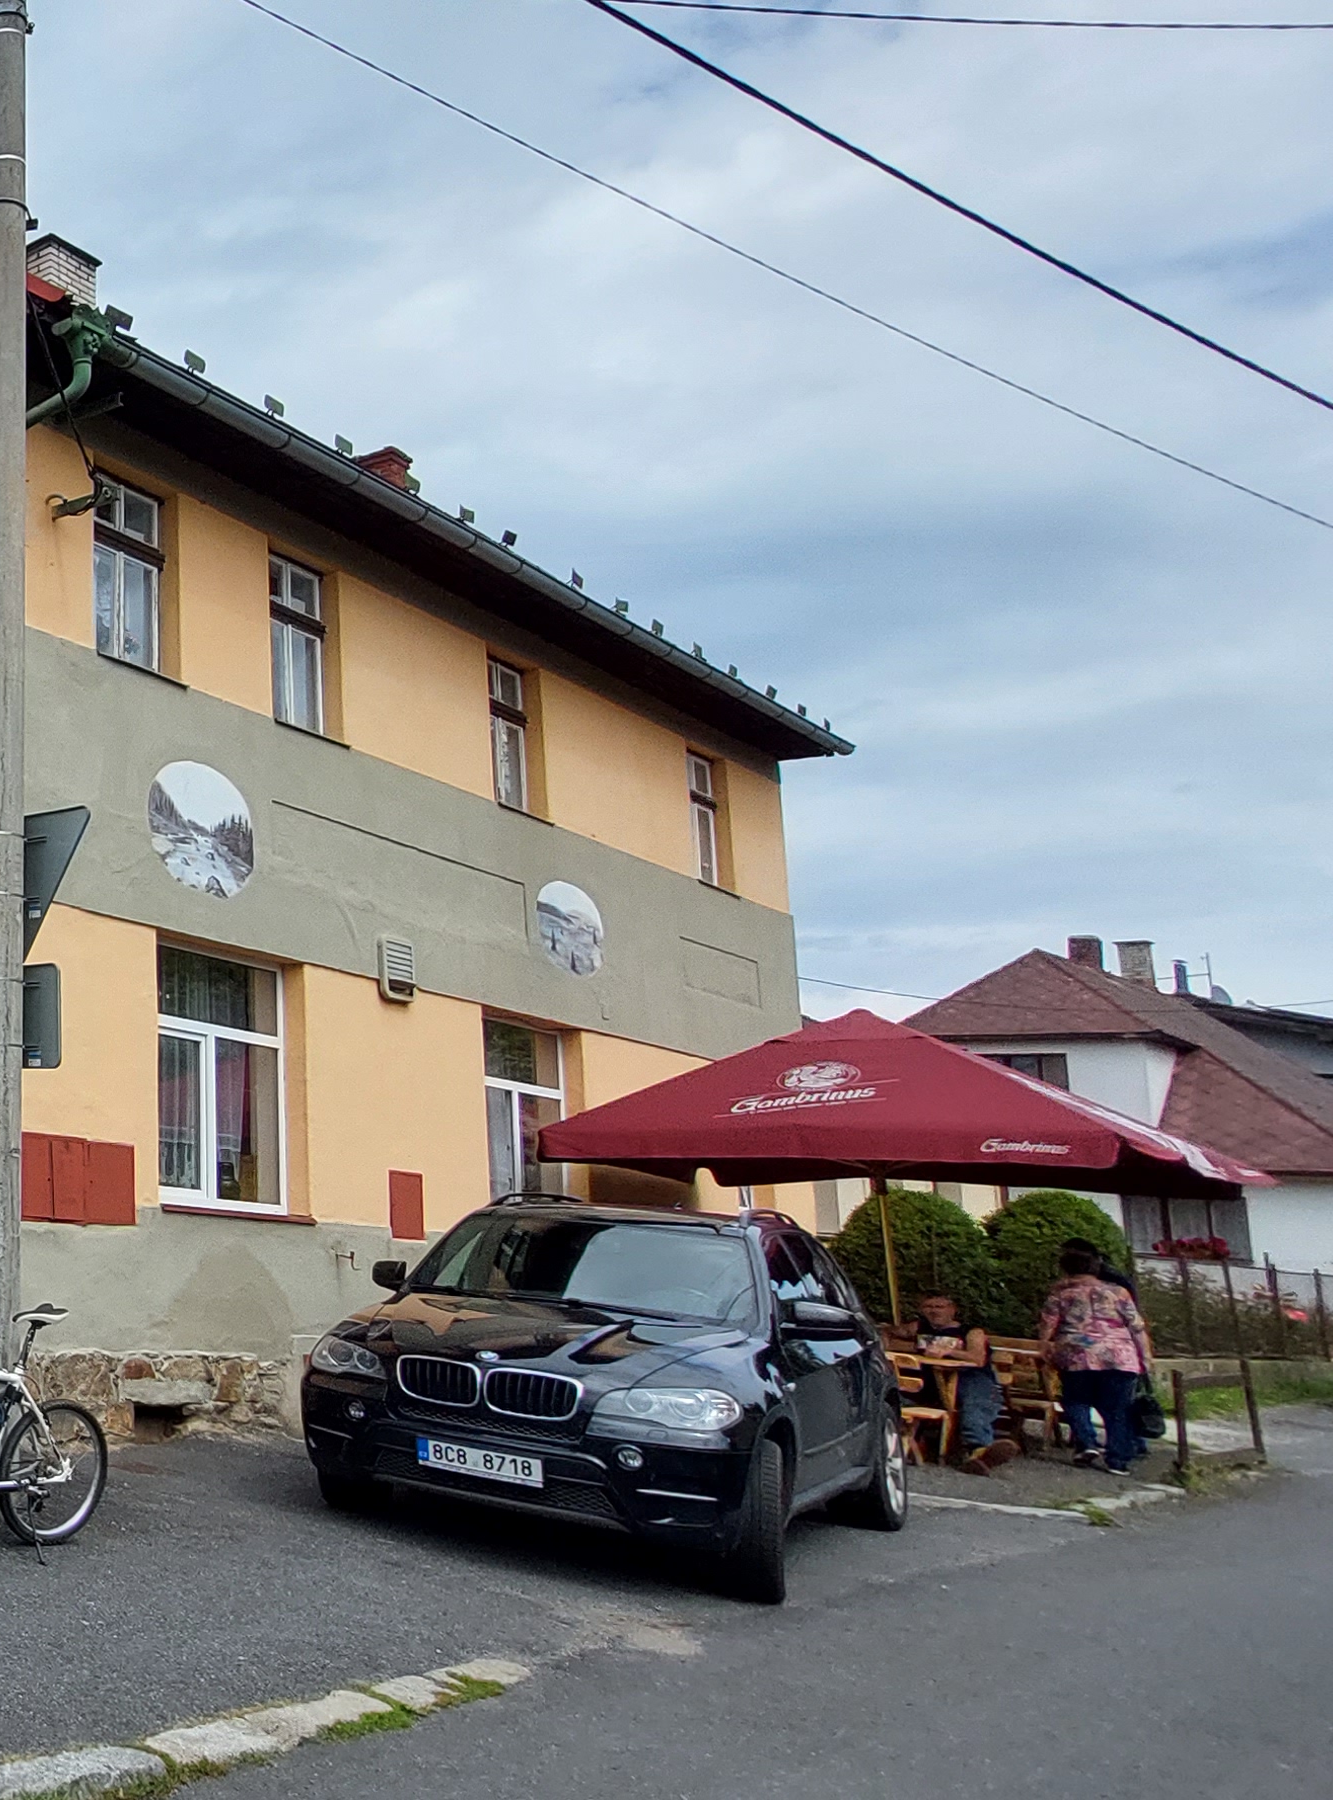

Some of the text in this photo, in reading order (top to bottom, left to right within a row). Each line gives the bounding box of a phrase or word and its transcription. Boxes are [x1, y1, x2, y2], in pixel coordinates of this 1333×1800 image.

[730, 1087, 877, 1115] Gambrinus
[979, 1138, 1072, 1155] Gambrinus
[432, 1443, 533, 1477] 8C8 8718
